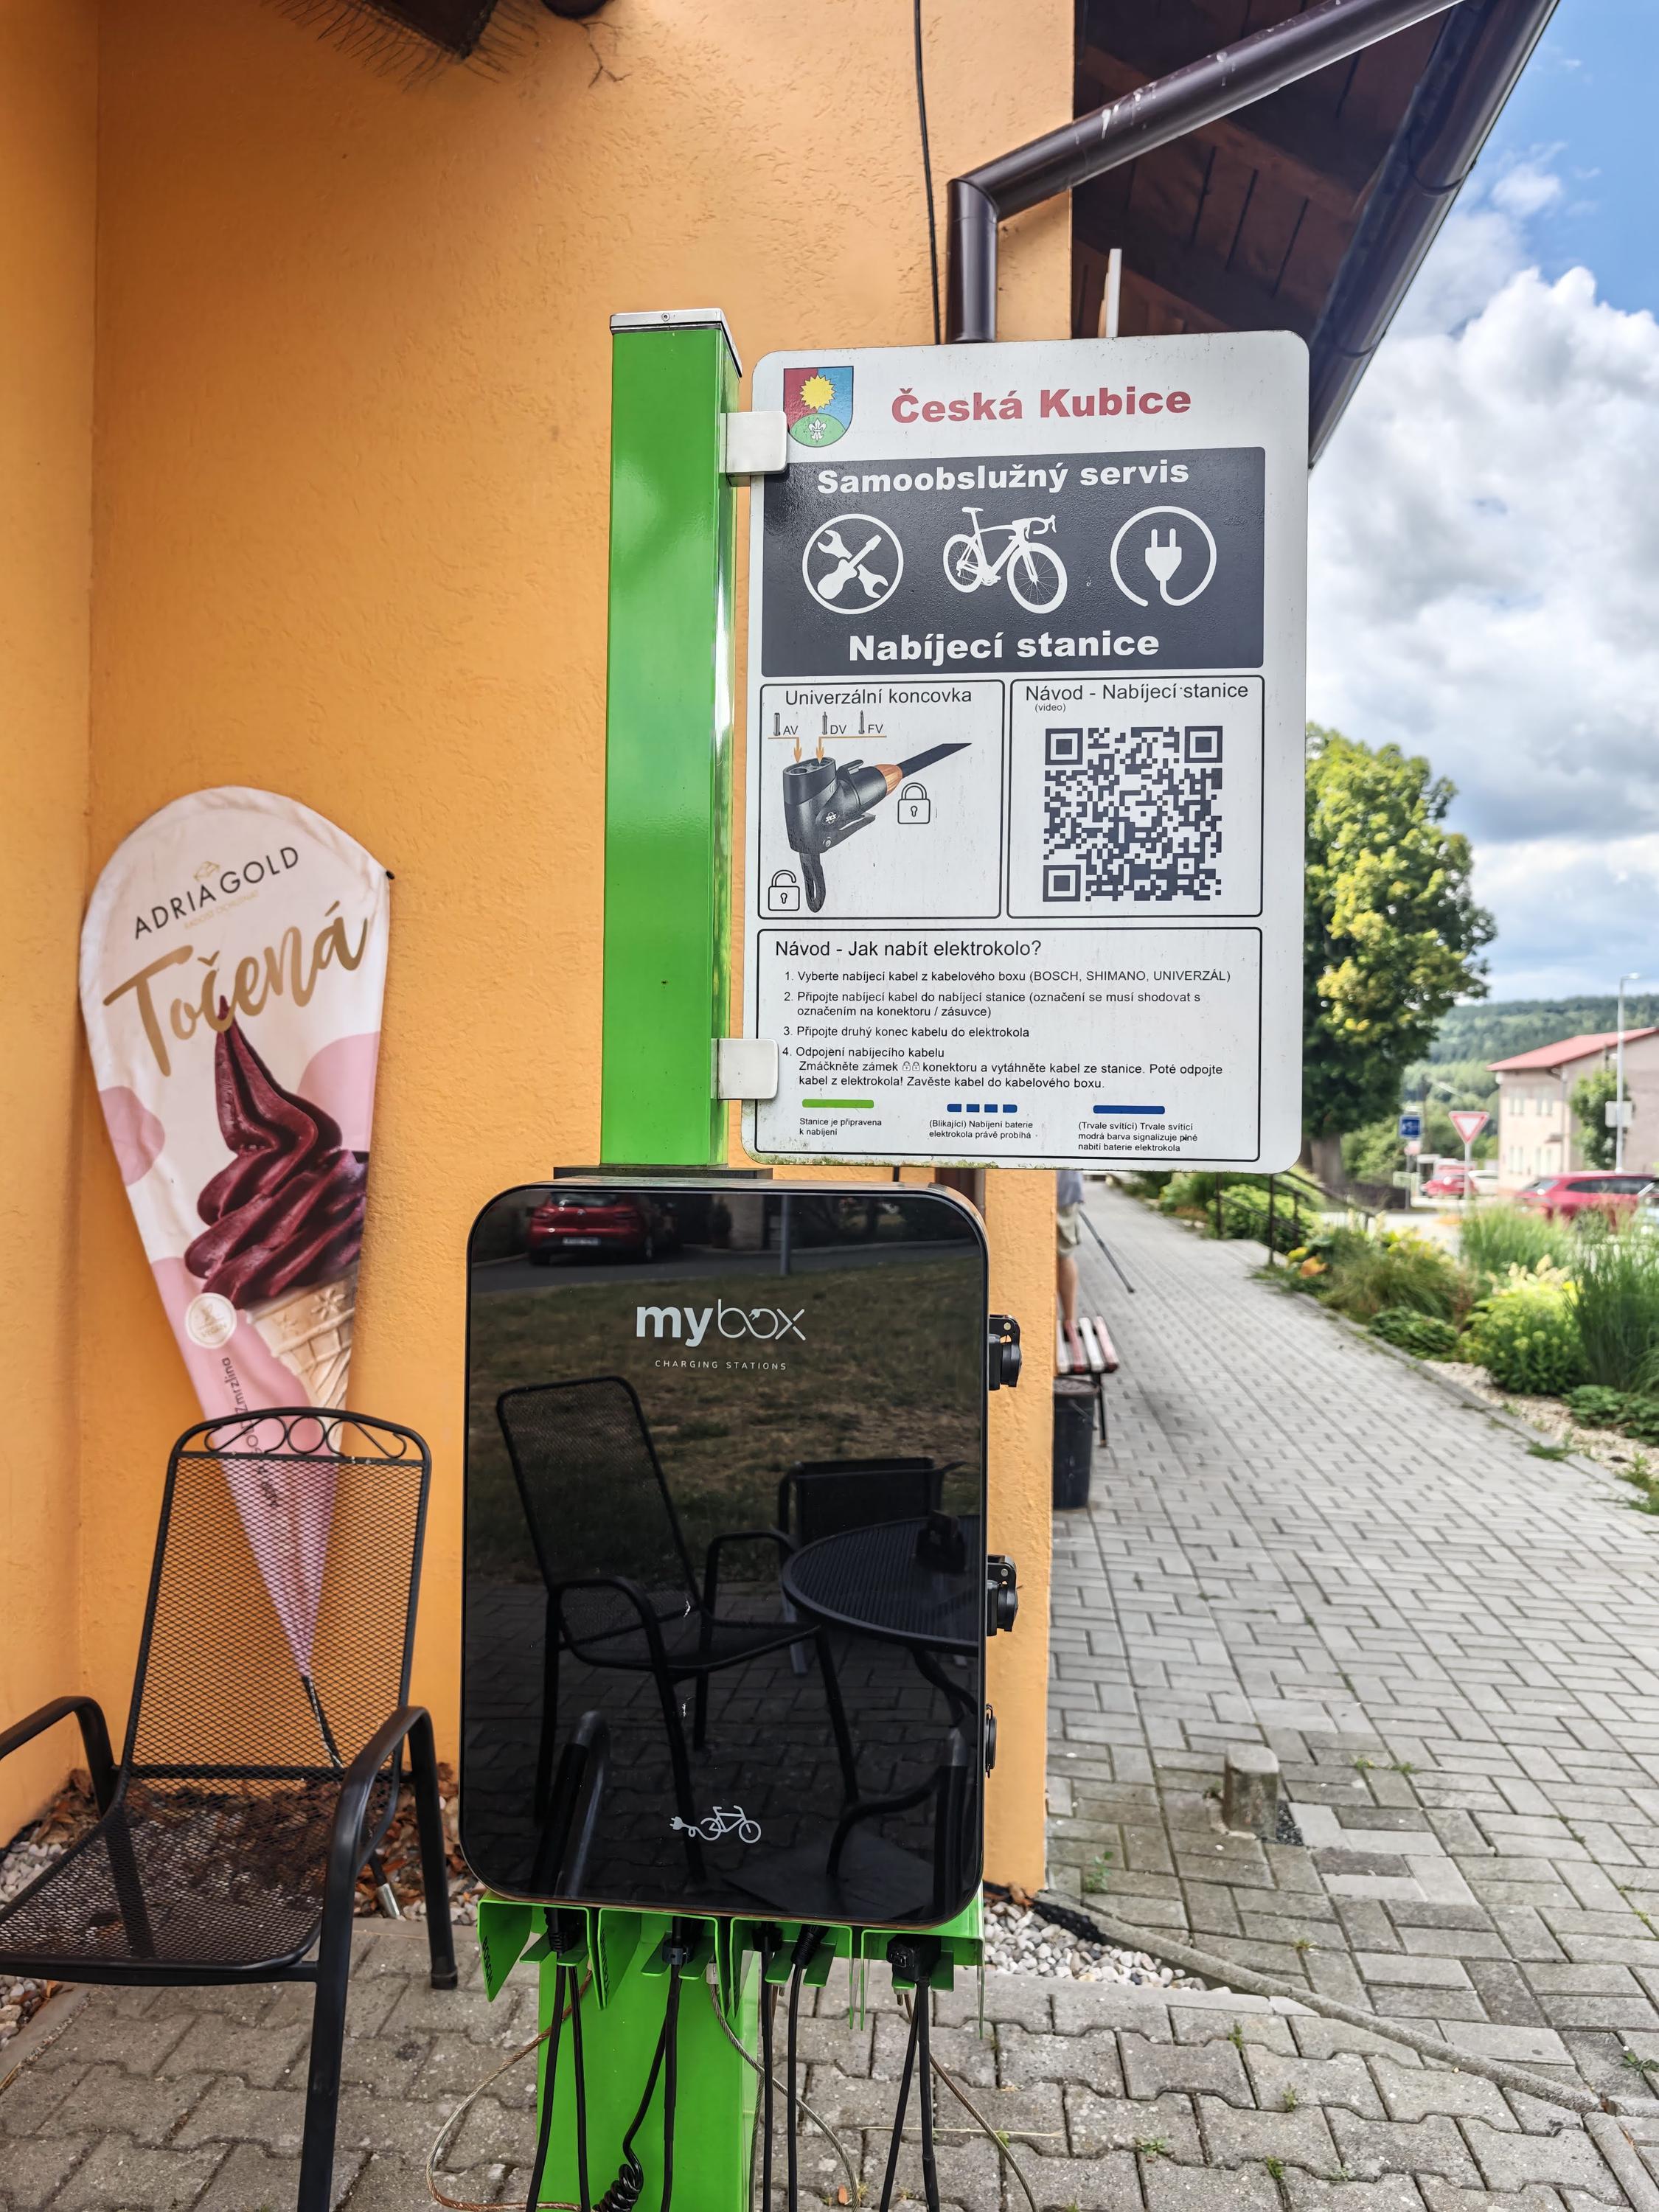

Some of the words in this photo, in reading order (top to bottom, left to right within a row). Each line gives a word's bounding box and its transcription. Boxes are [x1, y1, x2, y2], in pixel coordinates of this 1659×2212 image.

[892, 389, 1023, 423] Česká
[1040, 386, 1192, 419] Kubice
[818, 462, 1068, 493] Samoobslužný
[1080, 459, 1189, 485] servis
[850, 632, 1004, 666] Nabíjecí
[1017, 630, 1158, 657] stanice
[786, 689, 882, 705] Univerzální
[889, 688, 971, 703] koncovka
[1026, 685, 1082, 700] Návod
[1103, 684, 1177, 703] Nabíjecí
[1184, 683, 1248, 698] stanice
[1035, 703, 1065, 713] (video)
[783, 726, 798, 735] AV
[830, 725, 846, 734] DV
[869, 724, 883, 734] FV
[776, 941, 830, 956] Návod
[849, 942, 877, 956] Jak
[885, 941, 928, 956] nabít
[934, 940, 1041, 956] elektrokolo?
[785, 972, 793, 981] 1.
[798, 971, 838, 983] Vyberte
[843, 972, 885, 983] nabíjecí
[889, 972, 917, 981] kabel
[932, 971, 995, 981] kabelového
[999, 972, 1025, 981] boxu
[1030, 971, 1081, 983] (BOSCH,
[1086, 971, 1148, 981] SHIMANO,
[1154, 969, 1230, 982] UNIVERZÁL)
[102, 900, 368, 1077] Točená
[785, 992, 793, 1001] 2.
[798, 992, 838, 1004] Připojte
[843, 992, 884, 1004] nabíjecí
[889, 992, 917, 1001] kabel
[922, 992, 934, 1001] do
[939, 992, 981, 1004] nabíjecí
[986, 992, 1025, 1001] stanice
[1030, 992, 1085, 1004] (označení
[1107, 992, 1133, 1001] musí
[1138, 992, 1190, 1001] shodovat
[798, 1006, 856, 1015] označením
[877, 1006, 930, 1016] konektoru
[934, 1006, 938, 1015] /
[942, 1007, 991, 1018] zásuvce)
[784, 1026, 793, 1035] 3.
[798, 1026, 838, 1038] Připojte
[842, 1026, 872, 1038] druhý
[876, 1027, 908, 1036] konec
[912, 1027, 947, 1037] kabelu
[952, 1027, 964, 1037] do
[969, 1028, 1029, 1037] elektrokola
[782, 1048, 792, 1056] 4.
[796, 1047, 844, 1059] Odpojení
[849, 1048, 904, 1059] nabíjecího
[909, 1048, 944, 1057] kabelu
[799, 1061, 858, 1071] Zmáčkněte
[863, 1062, 898, 1071] zámek
[923, 1062, 976, 1071] konektoru
[992, 1063, 1046, 1074] vytáhněte
[1050, 1063, 1079, 1073] kabel
[1101, 1063, 1145, 1074] stanice.
[1150, 1064, 1175, 1074] Poté
[1180, 1065, 1222, 1077] odpojte
[799, 1076, 827, 1085] kabel
[841, 1076, 902, 1085] elektrokola!
[907, 1077, 950, 1086] Zavěste
[955, 1077, 984, 1086] kabel
[988, 1077, 1001, 1087] do
[1006, 1078, 1069, 1088] kabelového
[1074, 1078, 1104, 1088] boxu.
[831, 1118, 838, 1127] je
[841, 1119, 881, 1127] připravena
[970, 1121, 1002, 1129] Nabíjení
[1079, 1122, 1107, 1130] (Trvale
[807, 1129, 837, 1137] nabíjení
[1133, 1134, 1177, 1142] signalizuje
[726, 1362, 785, 1370] STATIONS
